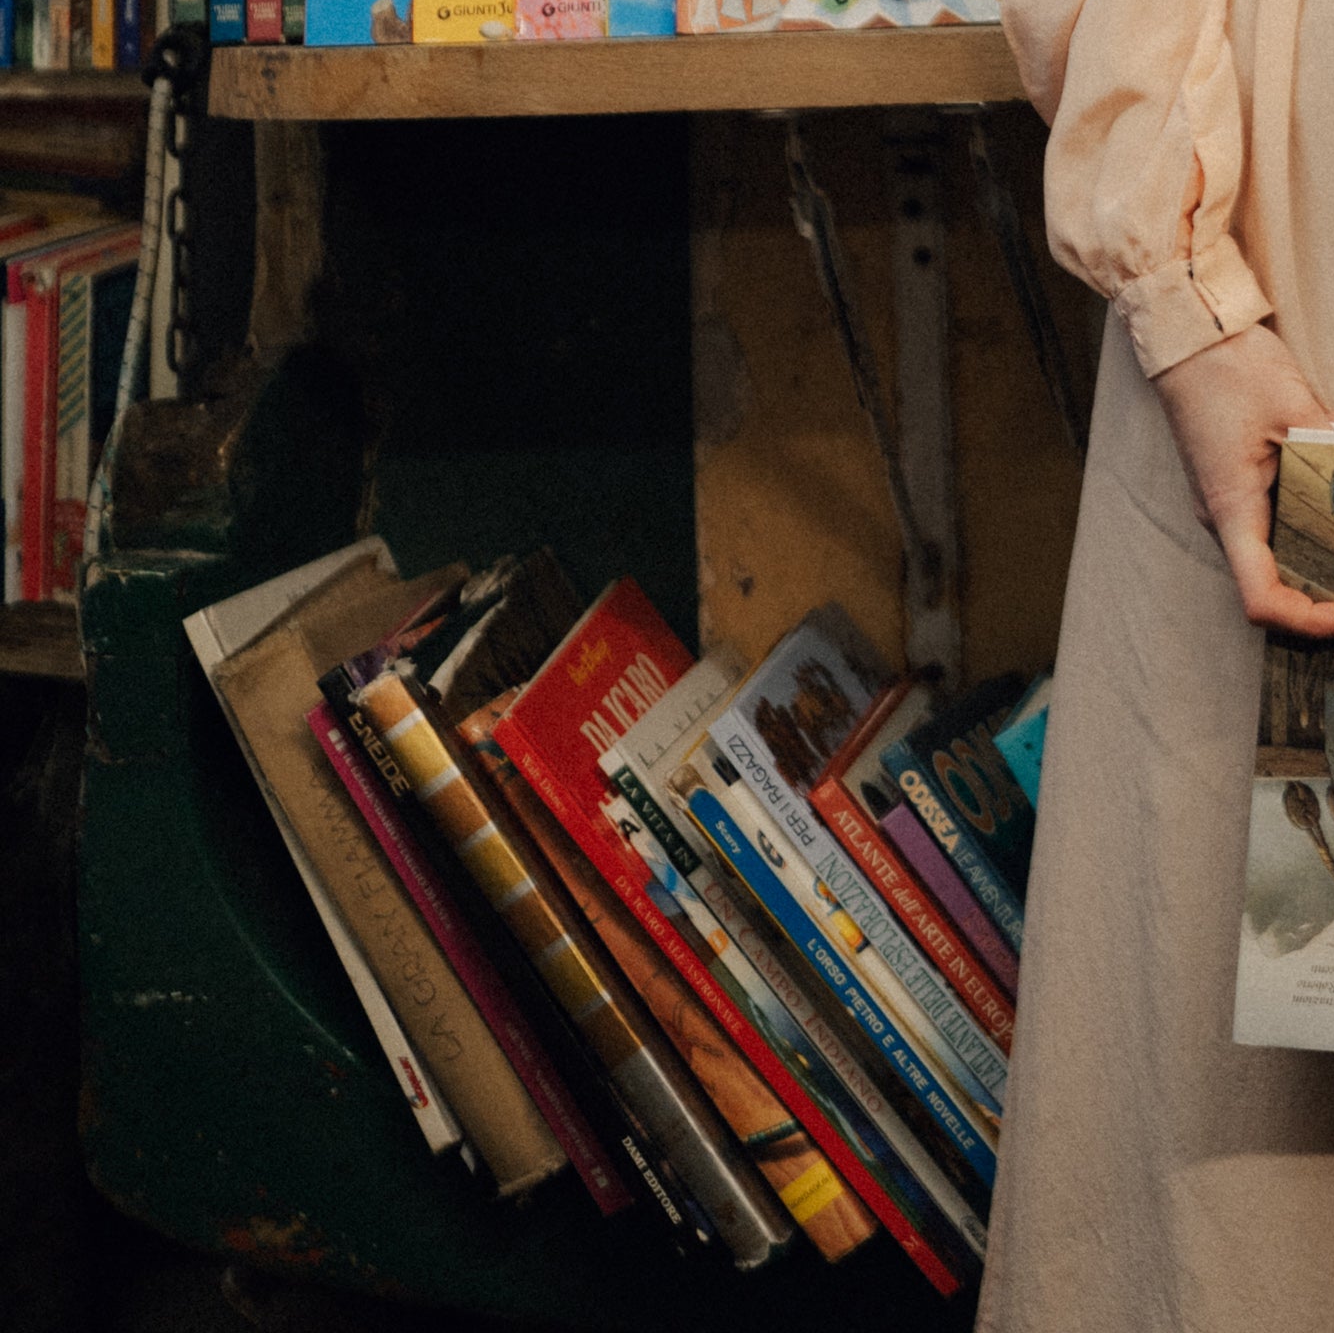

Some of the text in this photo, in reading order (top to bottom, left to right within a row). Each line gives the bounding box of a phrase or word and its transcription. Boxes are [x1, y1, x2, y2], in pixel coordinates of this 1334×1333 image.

[453, 3, 497, 17] GIUNTI
[557, 1, 601, 15] GIUNTI
[580, 651, 670, 753] DA ICARO
[346, 708, 412, 799] ENEIDE
[517, 752, 570, 815] Walt Disney
[723, 731, 786, 806] RAGAZZI
[710, 818, 746, 856] Scarry
[783, 808, 819, 848] PER
[891, 765, 969, 854] ODISSEA
[611, 873, 637, 900] DA
[629, 895, 668, 938] ICARO
[811, 848, 920, 978] ESPLORAZIONI
[830, 805, 901, 888] ATLANTE
[910, 908, 956, 960] ARTE
[946, 954, 971, 980] IN
[804, 936, 978, 1151] L'ORSO PIETRO E ALTRE NOVELLE
[617, 1134, 688, 1225] DAMI EDITORE
